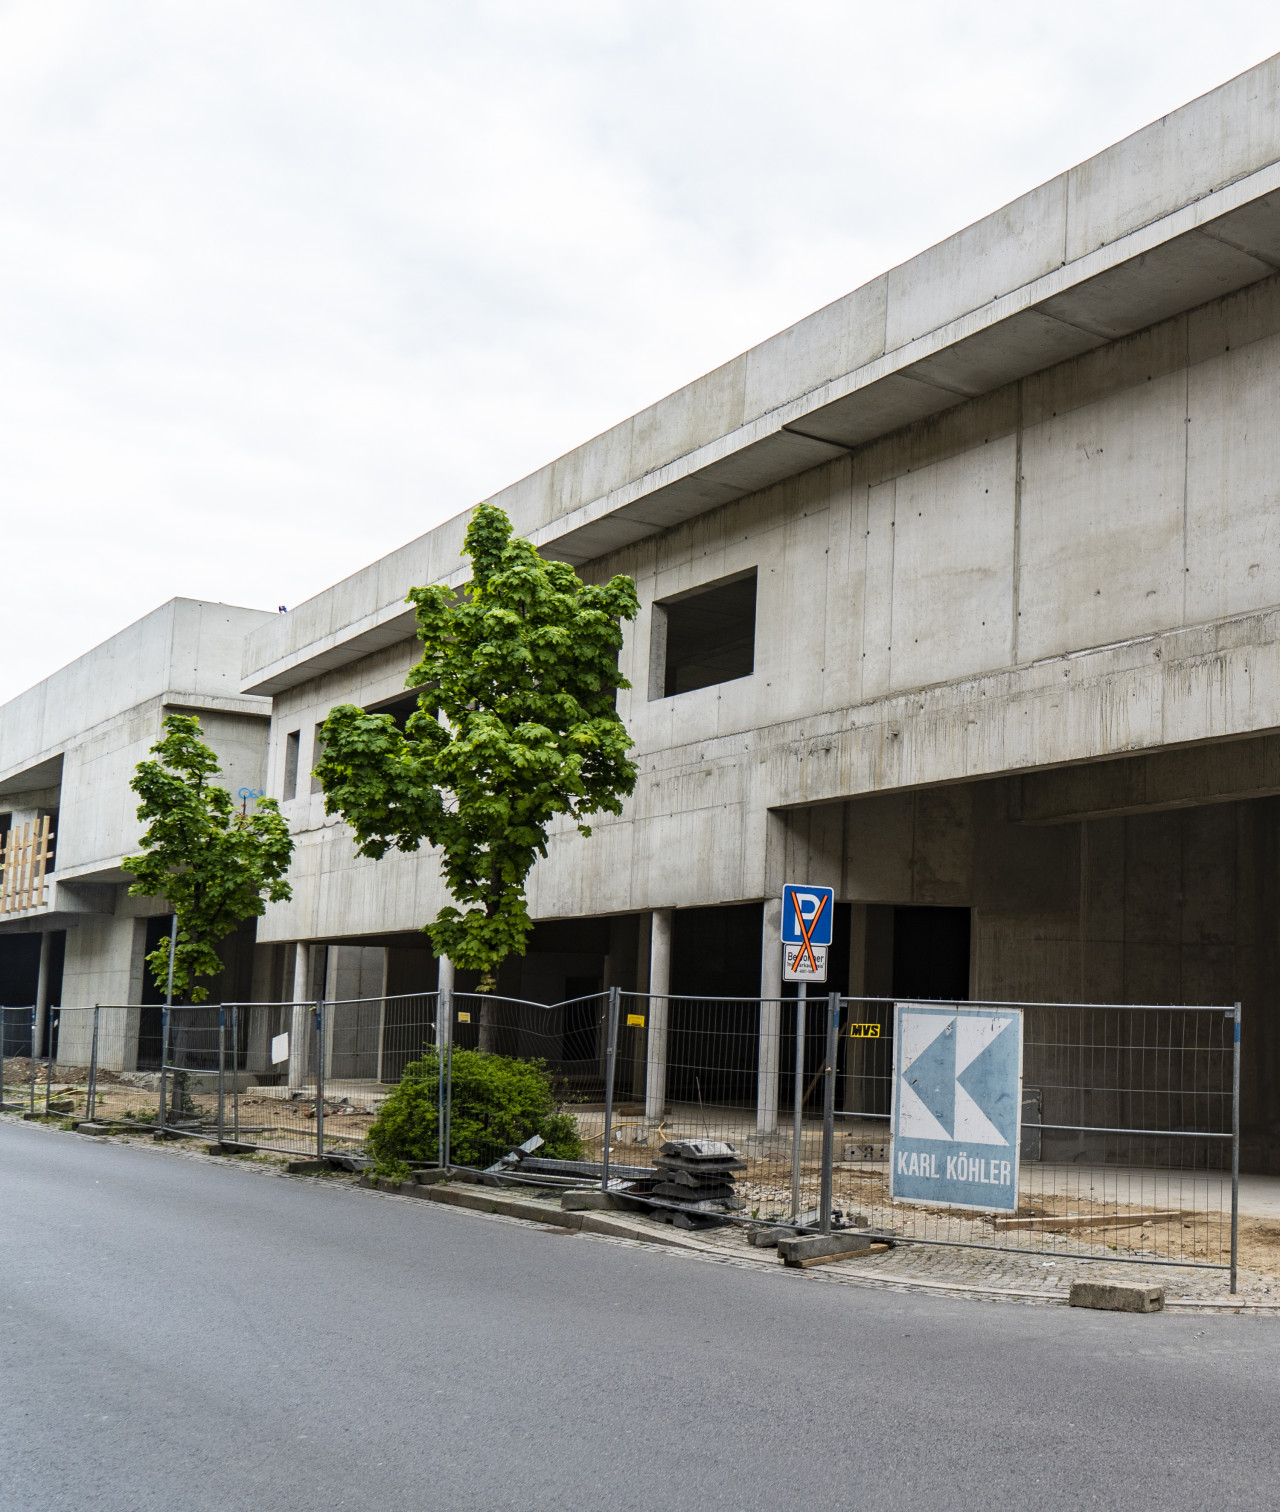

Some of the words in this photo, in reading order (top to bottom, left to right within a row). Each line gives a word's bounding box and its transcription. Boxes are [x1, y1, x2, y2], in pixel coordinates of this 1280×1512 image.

[851, 1024, 879, 1037] MVS
[897, 1151, 940, 1179] KARL
[946, 1151, 1011, 1186] KÖHLER
